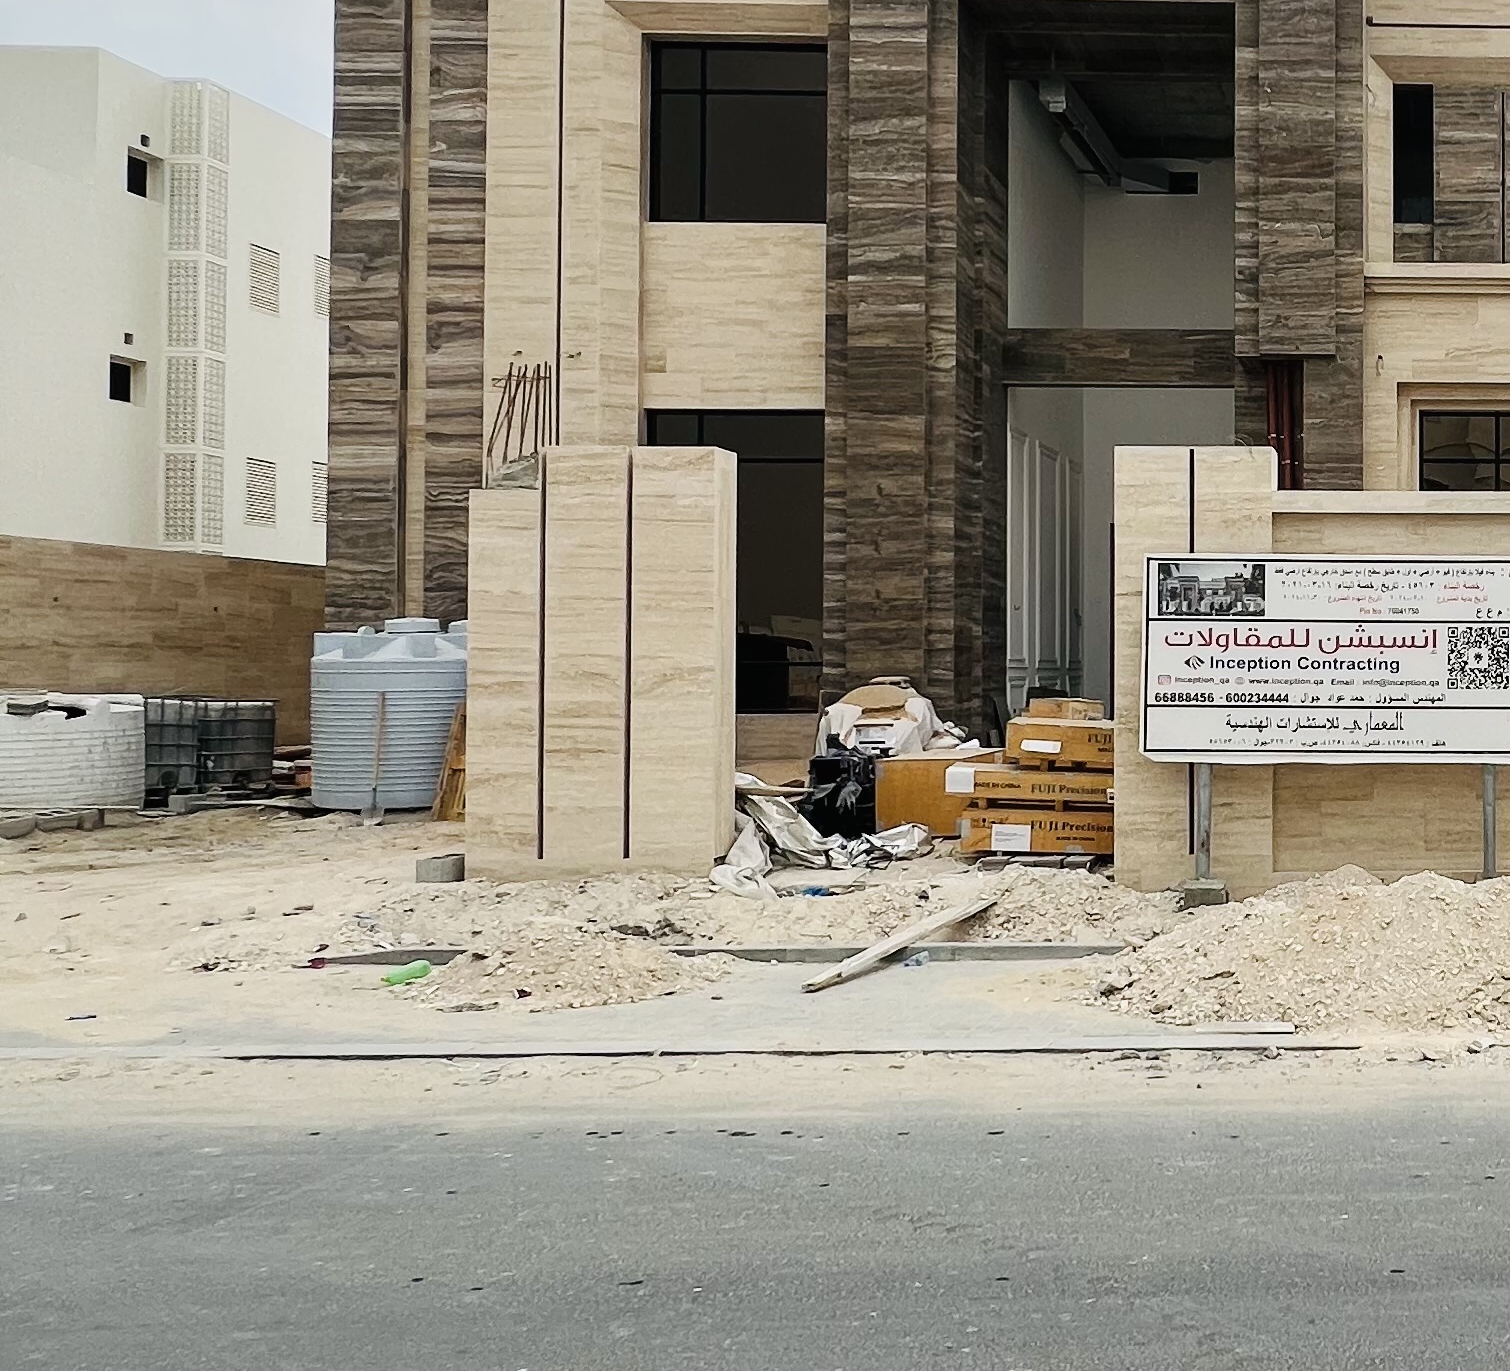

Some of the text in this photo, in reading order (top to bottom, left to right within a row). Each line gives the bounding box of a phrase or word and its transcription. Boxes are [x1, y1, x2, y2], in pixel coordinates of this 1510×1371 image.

[1164, 624, 1438, 655] إنسبشن للمقاولات
[1210, 655, 1400, 674] Inception Contracting
[1154, 693, 1215, 703] 66888456
[1226, 693, 1290, 703] 600234444
[1300, 693, 1320, 703] جوال
[1412, 693, 1446, 704] المهندس
[1226, 713, 1272, 733] الهندسية
[1088, 733, 1112, 744] FUJI
[1030, 783, 1107, 795] FUJI Precision
[1030, 820, 1114, 833] FUJI Precision
